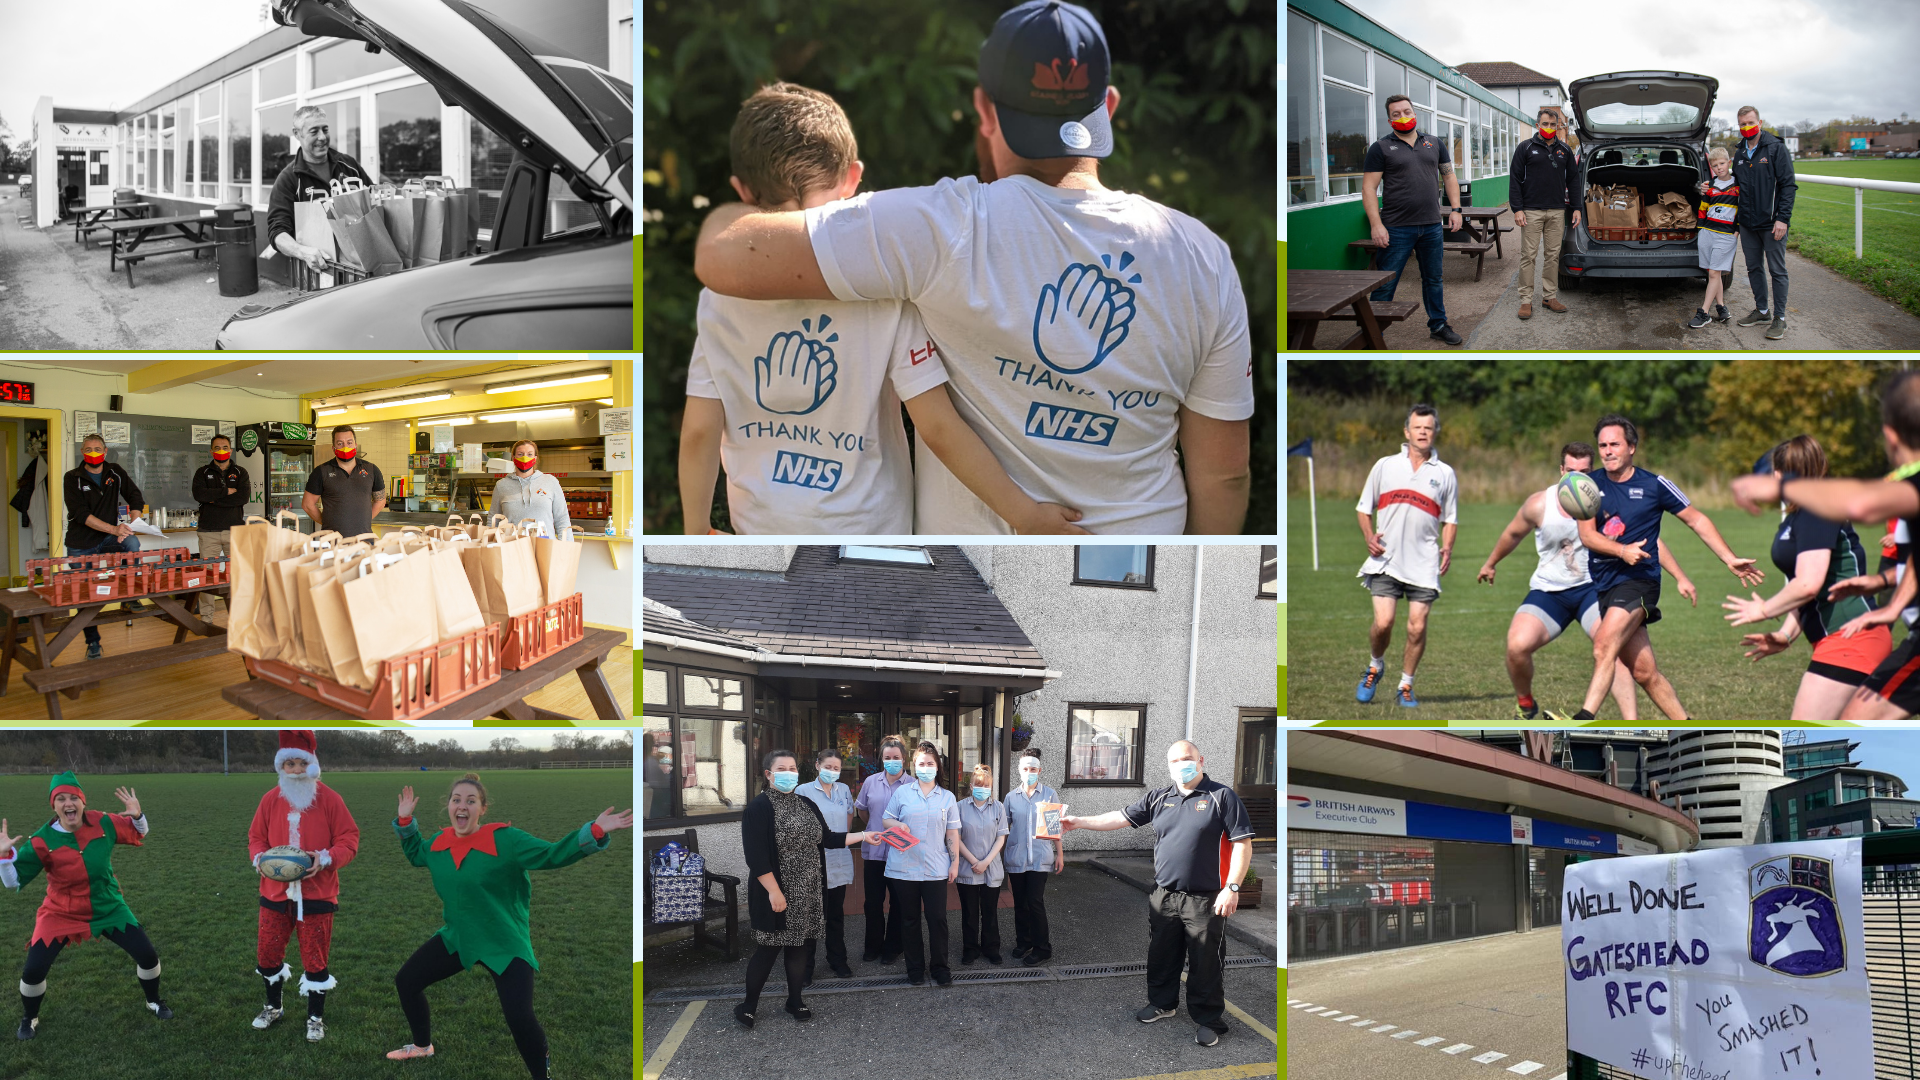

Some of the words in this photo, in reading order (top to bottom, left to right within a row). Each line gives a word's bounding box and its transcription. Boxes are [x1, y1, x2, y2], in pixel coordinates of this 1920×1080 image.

[1107, 389, 1163, 411] YOU
[738, 421, 823, 446] THANK
[1026, 404, 1116, 443] NHS
[773, 452, 841, 490] NHS
[1315, 800, 1356, 812] BRITISH
[1357, 805, 1396, 817] AIRWAYS
[1315, 811, 1358, 823] Executive
[1359, 815, 1378, 825] Club
[1564, 837, 1580, 846] BRITISH
[1566, 886, 1622, 922] WELL
[1628, 880, 1705, 915] DONE
[1567, 935, 1710, 982] GATESHEAD
[1604, 981, 1668, 1020] RFC
[1716, 1003, 1809, 1052] SMASHED
[1779, 1036, 1822, 1077] IT!
